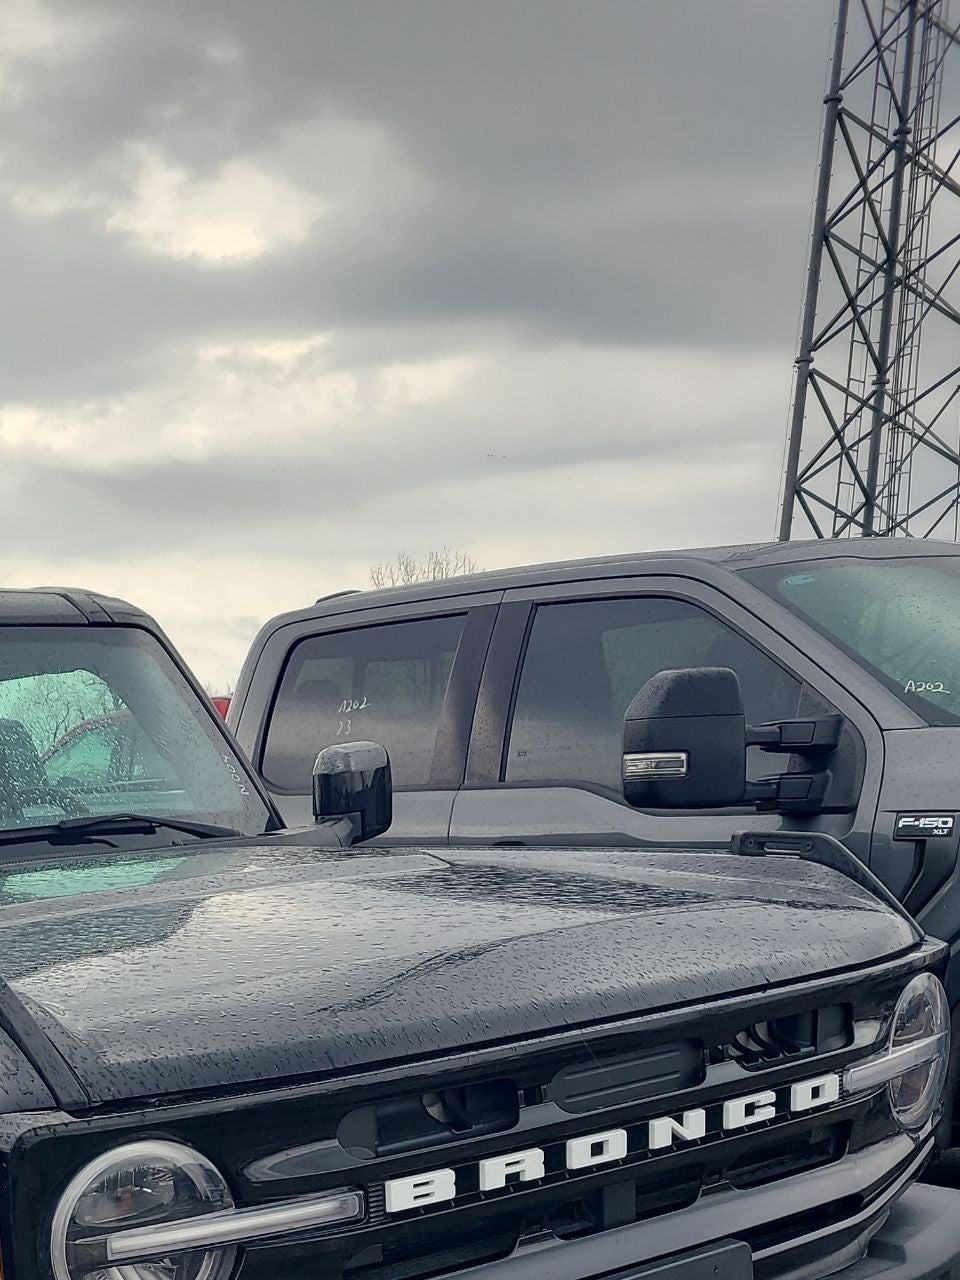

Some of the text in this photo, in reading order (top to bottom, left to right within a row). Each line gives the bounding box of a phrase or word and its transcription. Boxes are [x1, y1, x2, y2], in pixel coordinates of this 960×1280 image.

[904, 680, 951, 693] A202
[898, 817, 953, 828] F-150
[385, 1073, 839, 1213] BRONCO
